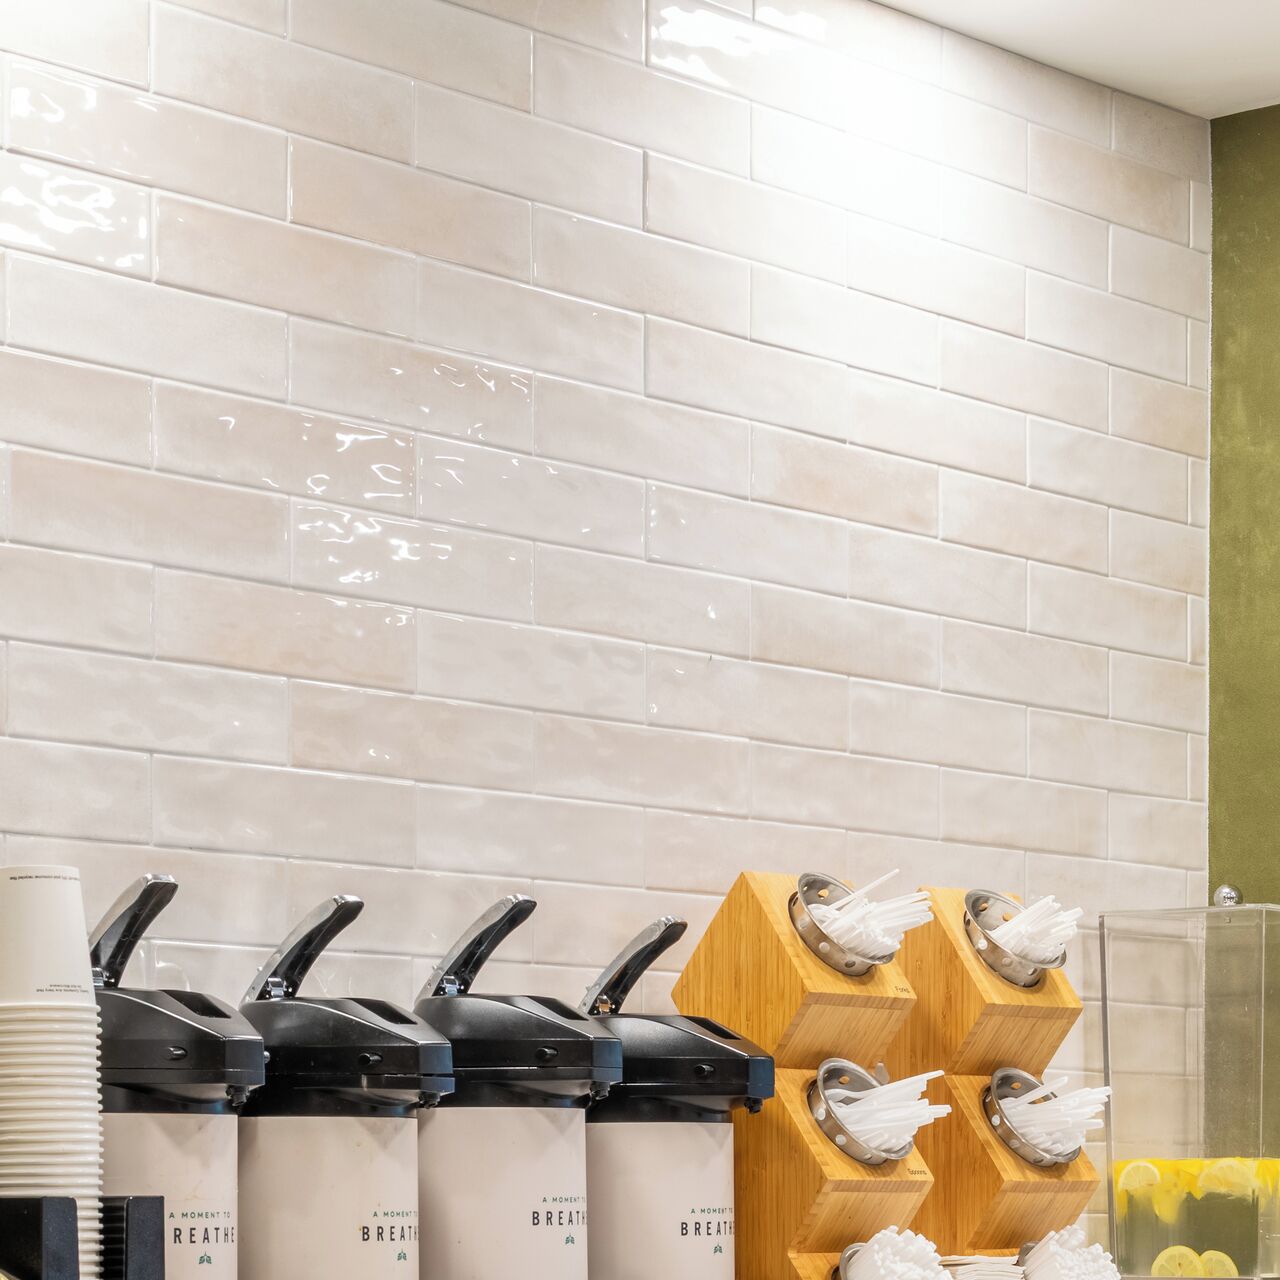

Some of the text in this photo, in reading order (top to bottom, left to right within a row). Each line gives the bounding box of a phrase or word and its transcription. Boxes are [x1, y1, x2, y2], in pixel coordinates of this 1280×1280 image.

[181, 1211, 220, 1219] MOMENT
[383, 1210, 412, 1218] MOMENT
[173, 1226, 235, 1244] REATHE
